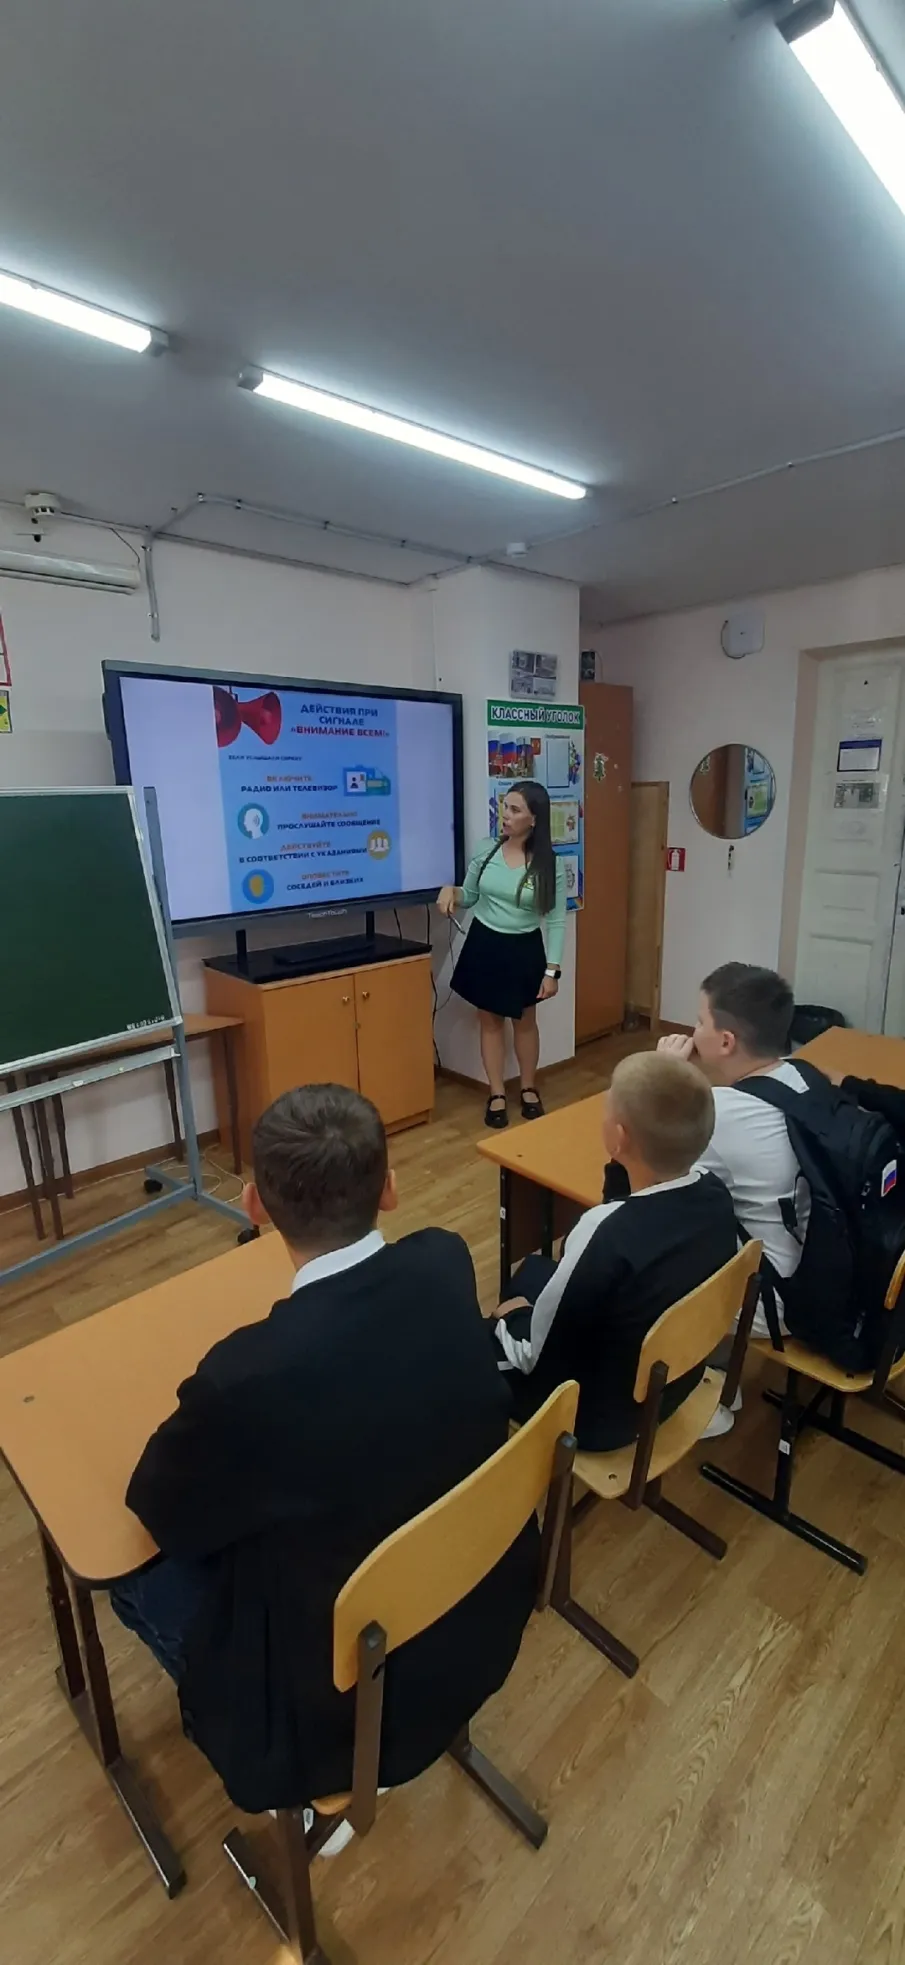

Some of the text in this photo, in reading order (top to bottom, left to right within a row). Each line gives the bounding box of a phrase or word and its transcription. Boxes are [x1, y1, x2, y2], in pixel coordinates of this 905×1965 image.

[300, 703, 378, 717] ДЕЙСТВИЯ ПРИ
[491, 706, 580, 724] КЛАССНЫЙ УГОЛОК
[319, 716, 365, 726] СИГНАЛЕ
[241, 785, 272, 793] РАДИО
[277, 819, 381, 830] ПРОСЛУШАЙТЕ СООБЩЕНИЕ
[246, 852, 310, 862] СООТВЕТСТВИИ
[286, 880, 323, 891] СОСЕДЕЙ
